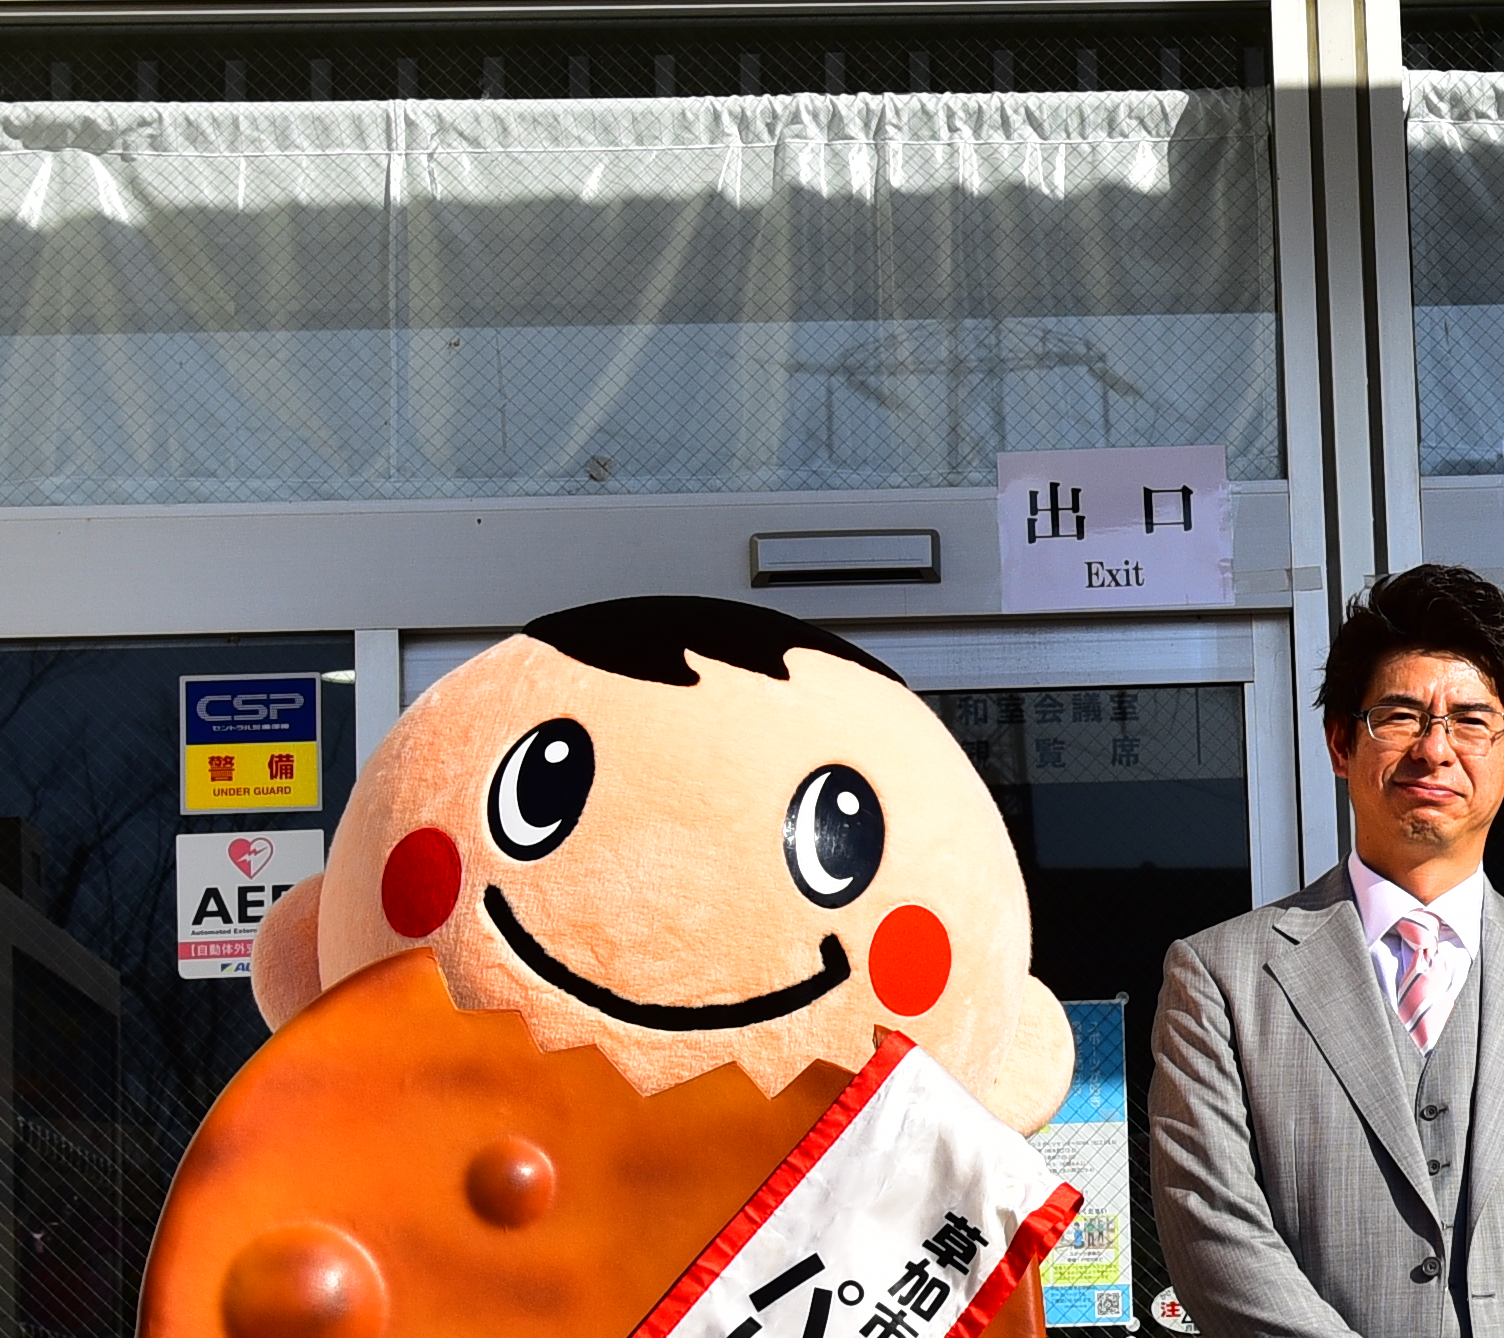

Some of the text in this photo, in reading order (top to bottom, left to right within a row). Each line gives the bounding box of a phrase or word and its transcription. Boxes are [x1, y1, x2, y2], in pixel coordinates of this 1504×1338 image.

[1026, 481, 1195, 545] 出口
[1084, 559, 1146, 590] Exit
[196, 692, 305, 722] CSP
[957, 693, 1141, 727] 和室会議室
[207, 753, 295, 782] 警備
[212, 785, 292, 798] UNDER GUARD
[190, 928, 232, 936] Automated
